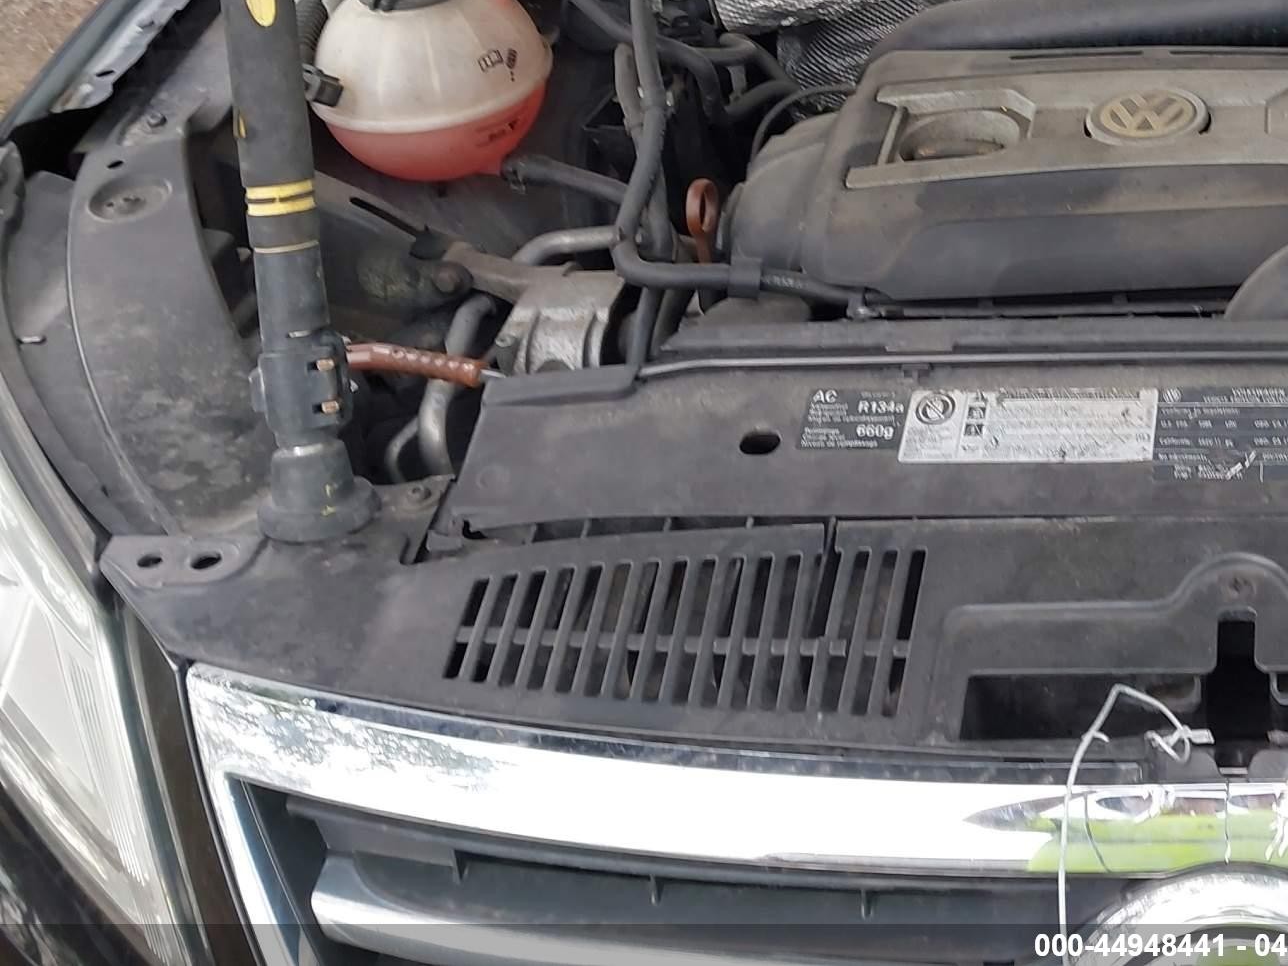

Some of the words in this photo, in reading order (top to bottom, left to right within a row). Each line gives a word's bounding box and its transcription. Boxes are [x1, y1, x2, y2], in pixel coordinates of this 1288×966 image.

[812, 389, 838, 403] AC
[857, 400, 904, 414] R134a
[855, 424, 894, 440] 660g
